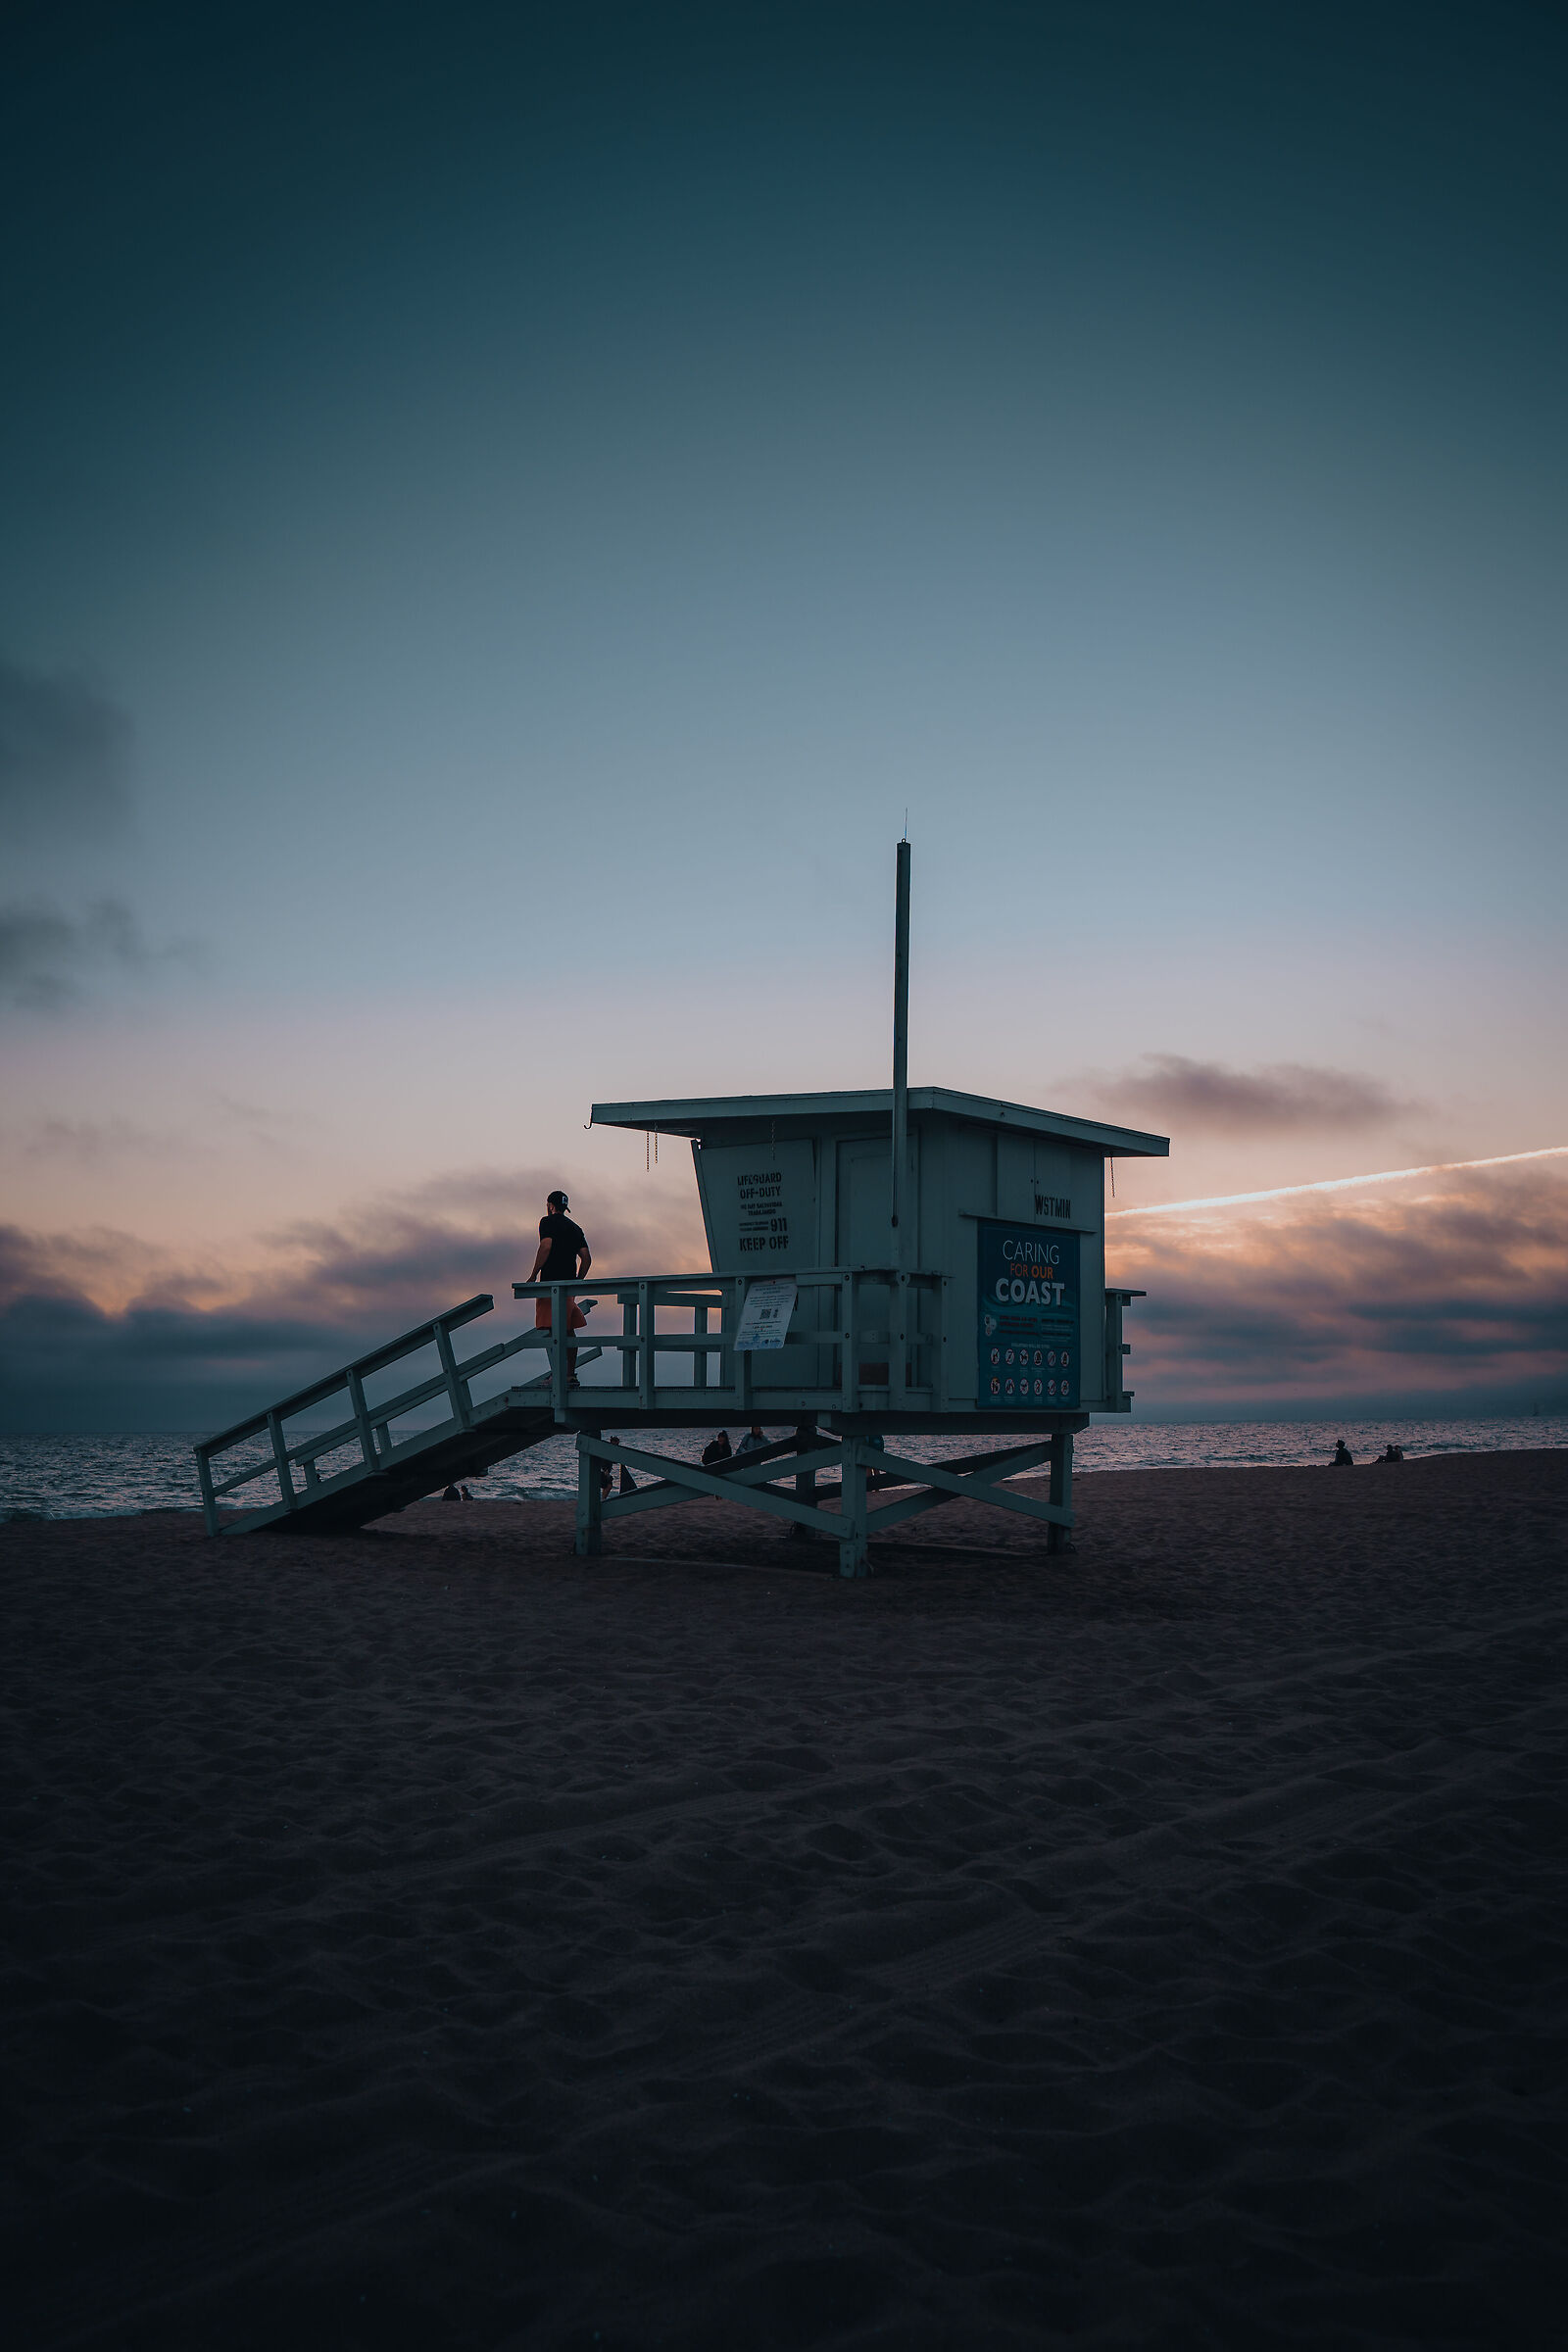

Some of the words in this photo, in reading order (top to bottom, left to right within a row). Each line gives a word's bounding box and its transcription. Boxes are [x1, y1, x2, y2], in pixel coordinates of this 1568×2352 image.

[737, 1172, 782, 1186] LIFEGUARD
[740, 1186, 781, 1200] OFF-DUTY
[1035, 1195, 1071, 1219] WSTMIN
[770, 1218, 787, 1232] 911
[740, 1237, 765, 1251] KEEP
[769, 1235, 789, 1250] OFF
[1003, 1240, 1060, 1265] CARING
[1010, 1262, 1029, 1277] FOR
[1031, 1264, 1054, 1279] OUR
[996, 1277, 1065, 1306] COAST
